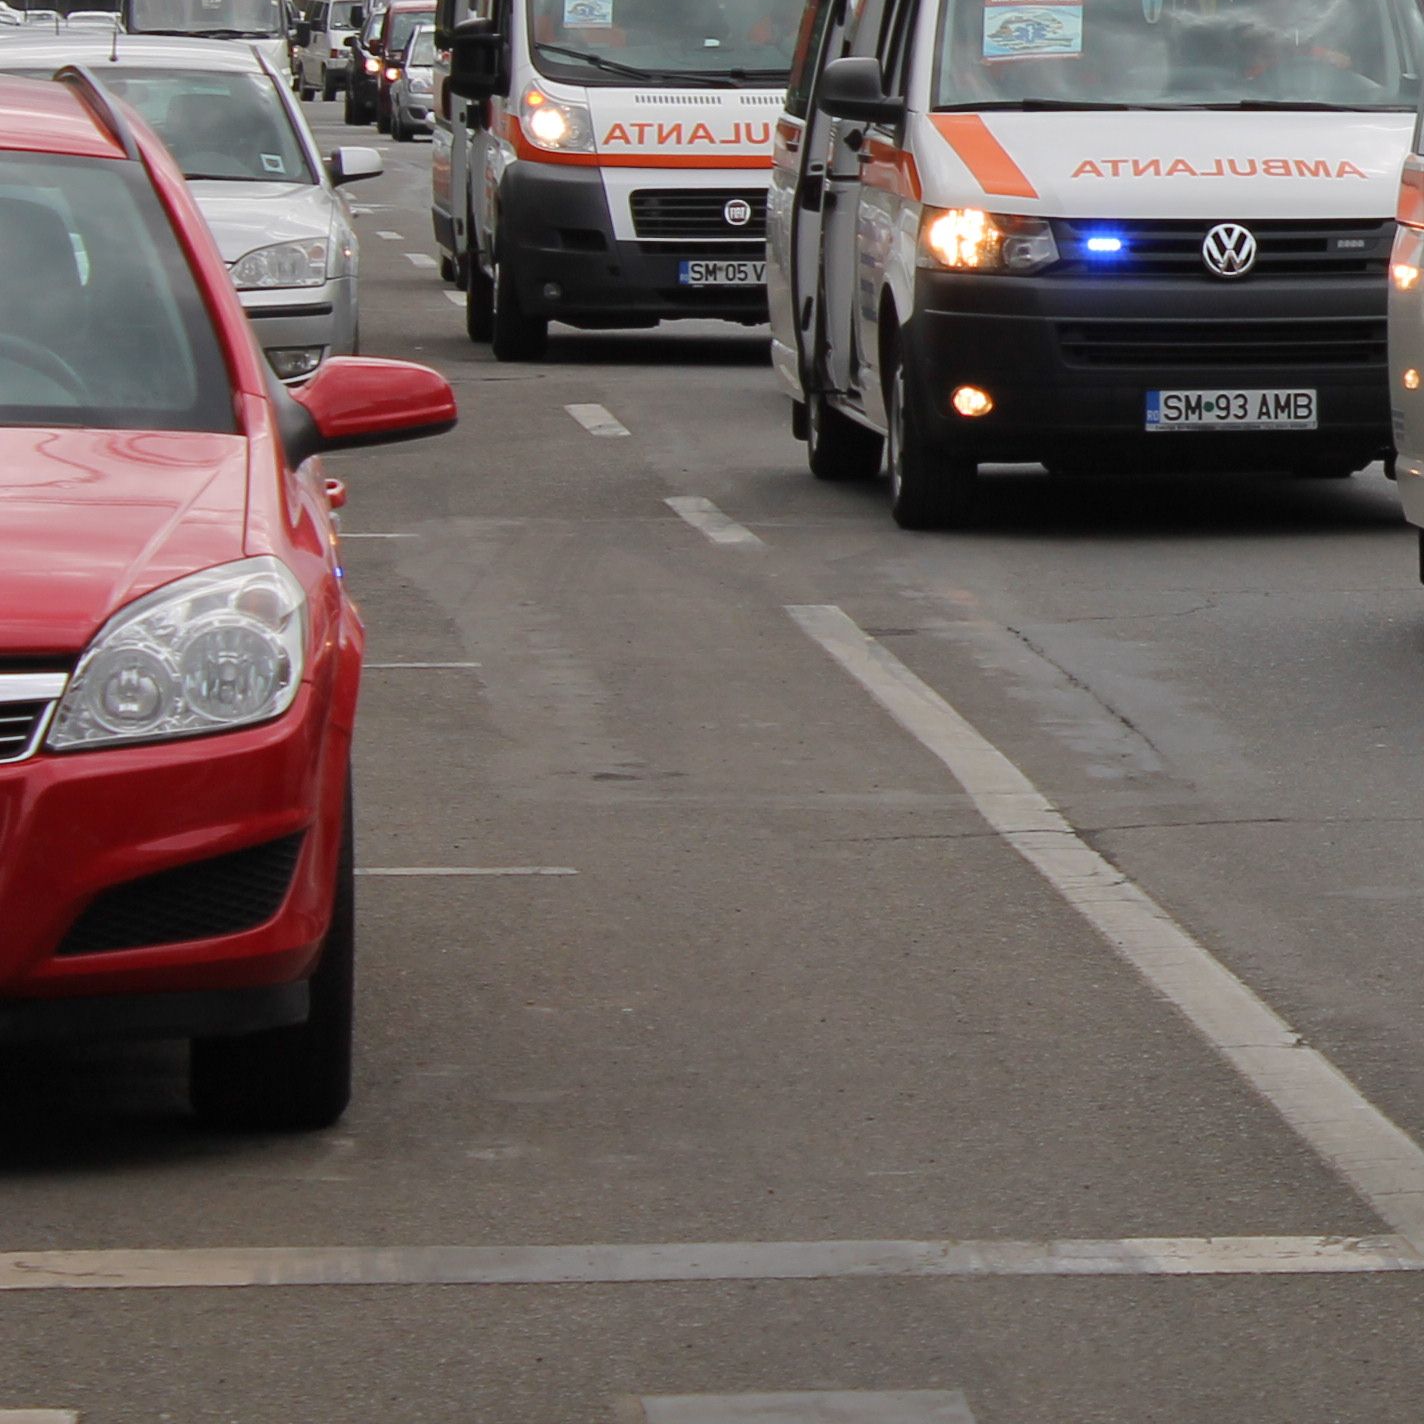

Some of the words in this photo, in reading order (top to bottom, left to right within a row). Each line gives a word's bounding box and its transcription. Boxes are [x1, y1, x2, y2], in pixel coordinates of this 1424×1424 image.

[690, 263, 717, 282] SM
[725, 263, 748, 282] 05
[1163, 394, 1202, 421] SM
[1215, 393, 1248, 420] 93
[1257, 392, 1313, 420] AMB
